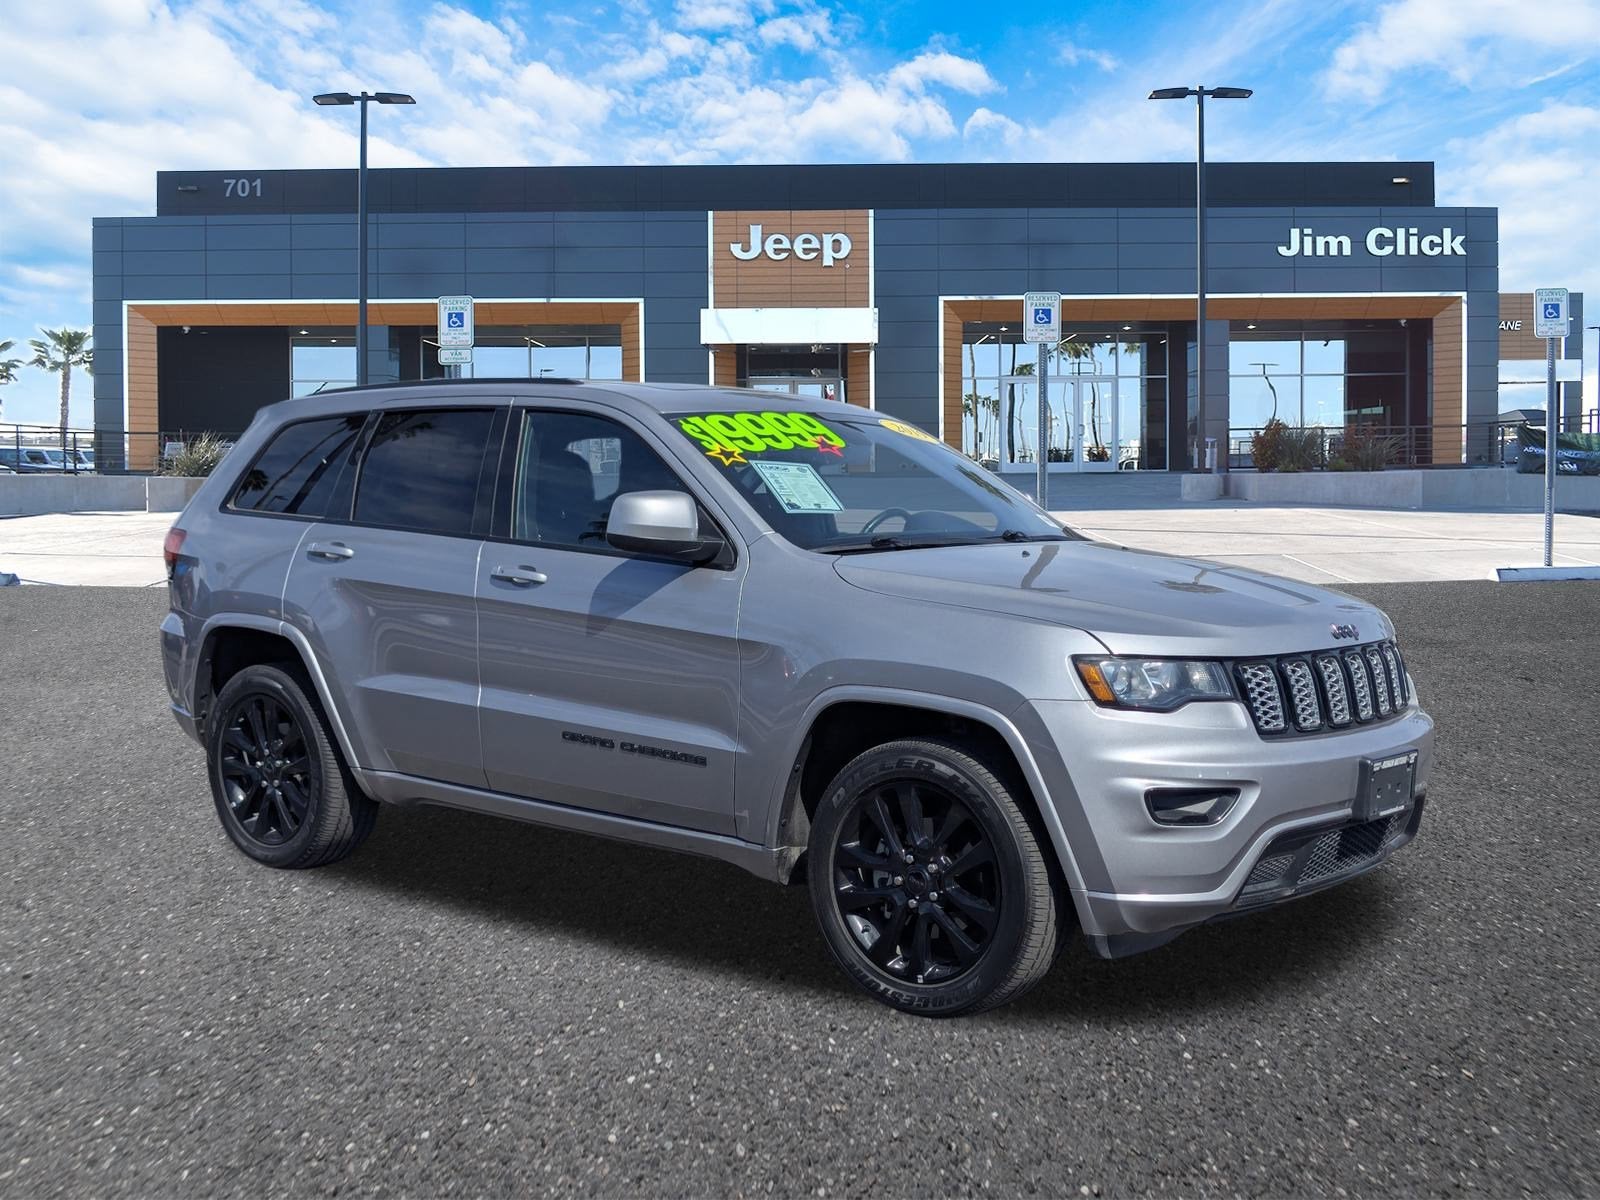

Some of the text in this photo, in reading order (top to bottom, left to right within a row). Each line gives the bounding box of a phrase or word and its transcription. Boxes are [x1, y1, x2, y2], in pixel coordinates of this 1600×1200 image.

[223, 178, 262, 197] 701
[730, 224, 852, 267] Jeep
[1277, 227, 1467, 257] Jim Click
